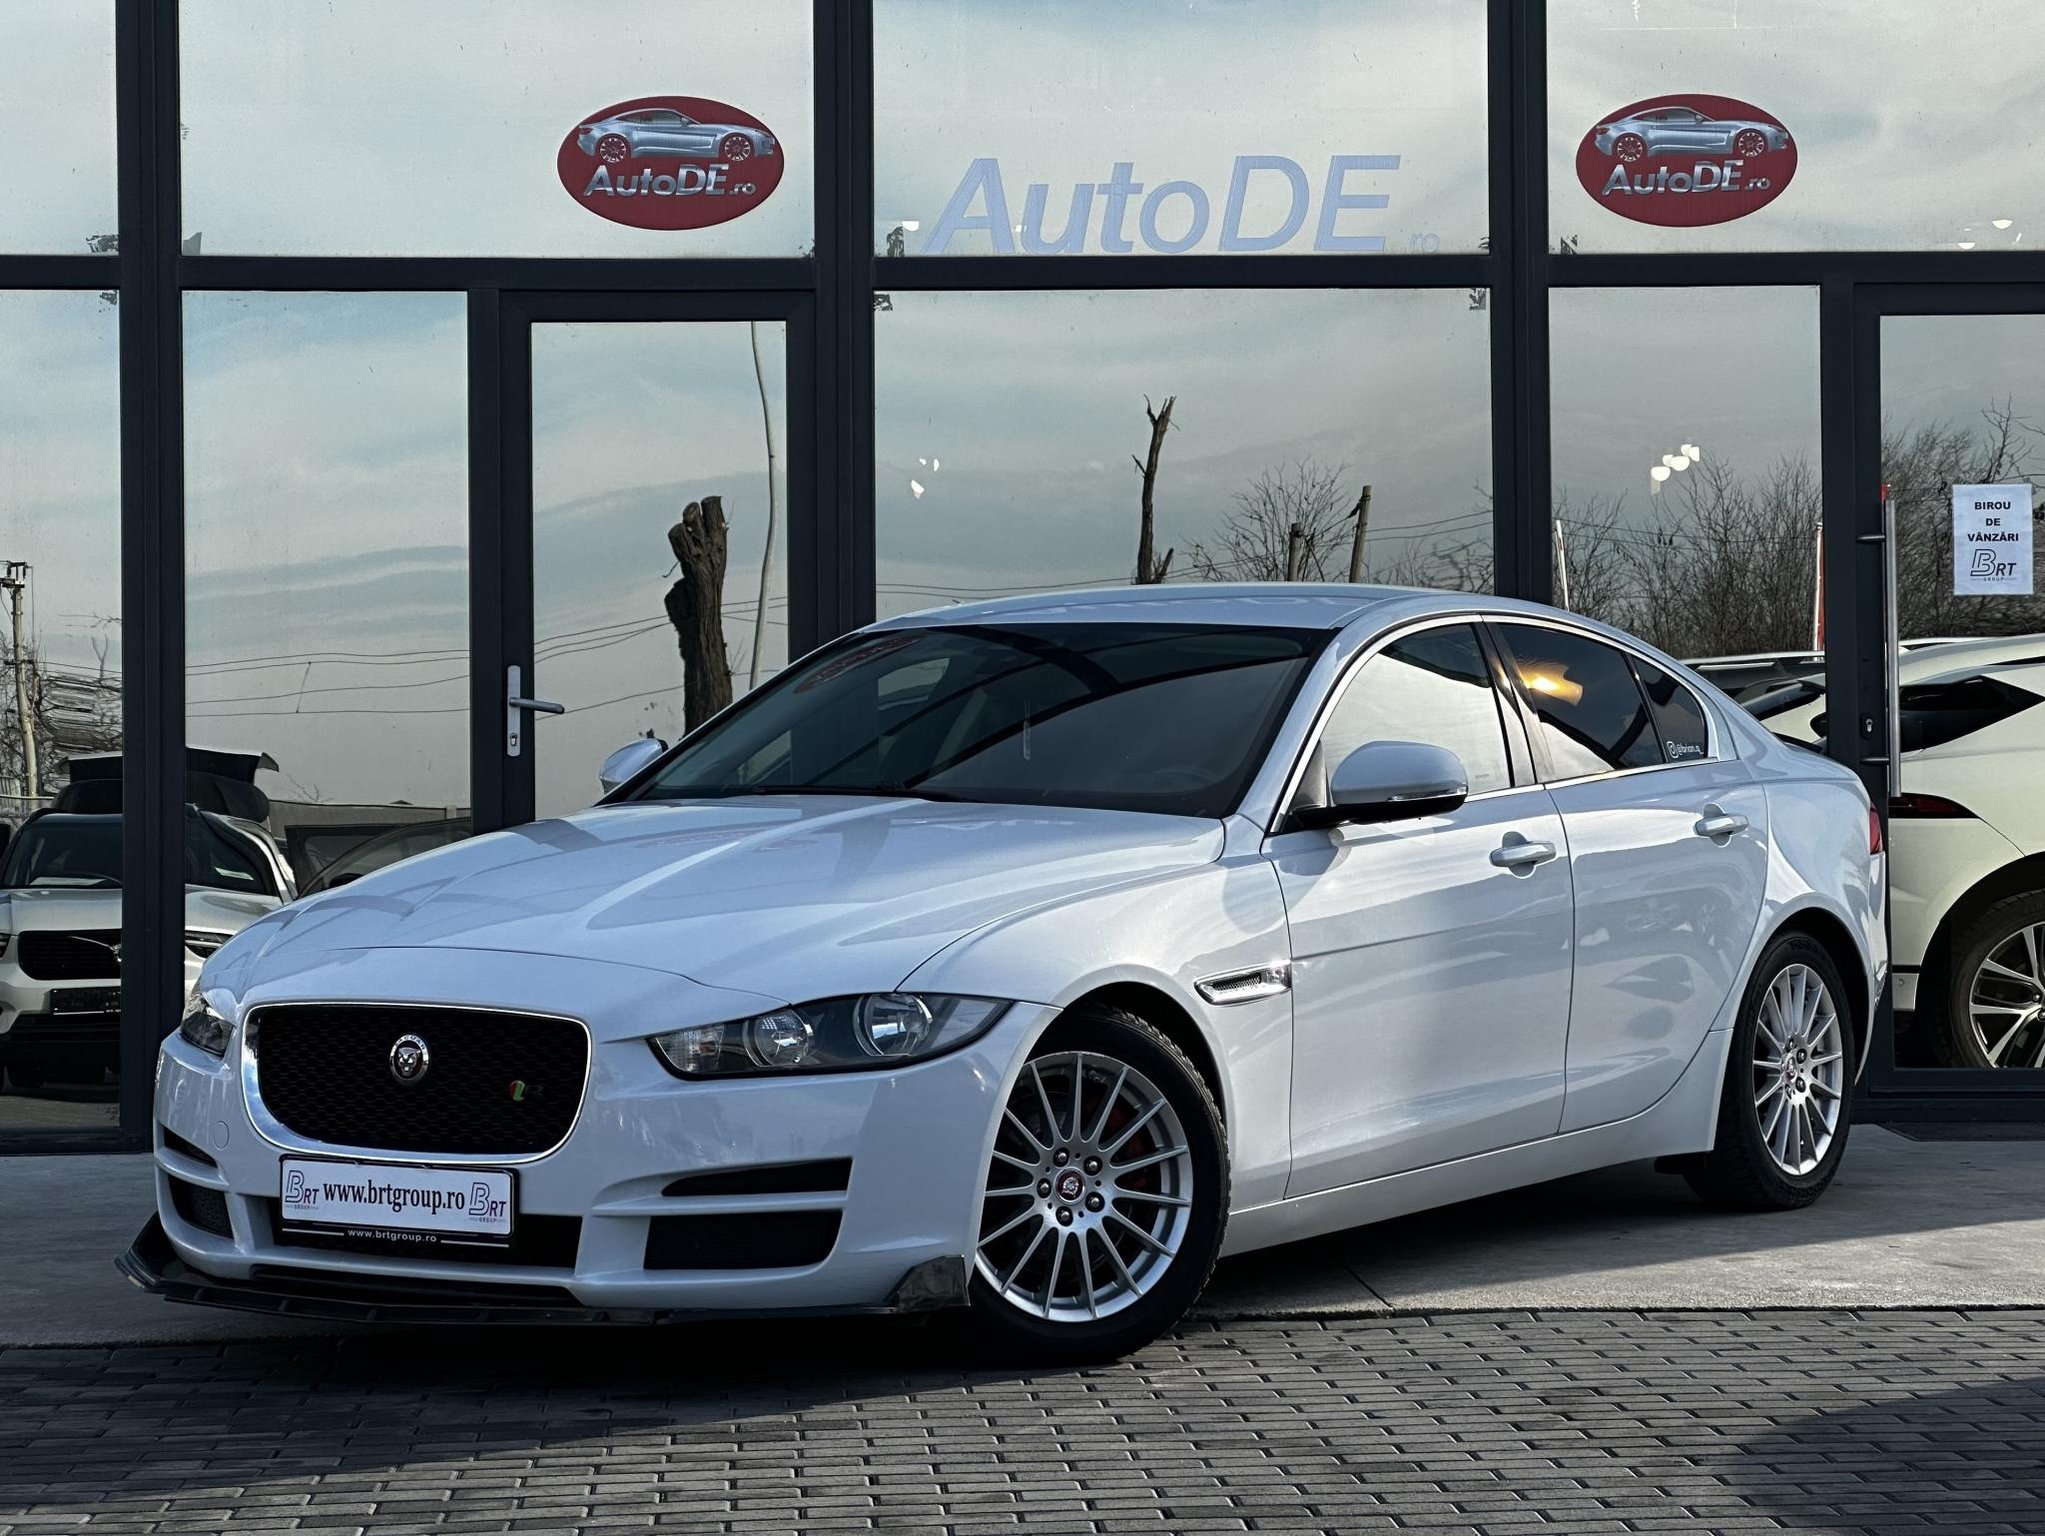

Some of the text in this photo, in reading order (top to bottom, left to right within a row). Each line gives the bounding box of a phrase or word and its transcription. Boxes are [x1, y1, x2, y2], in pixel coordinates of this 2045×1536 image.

[1974, 501, 2011, 510] BIROU
[1985, 518, 2001, 526] DE
[322, 1179, 465, 1215] www.brtgroup.ro
[347, 1229, 437, 1243] www.brtgroup.ro
